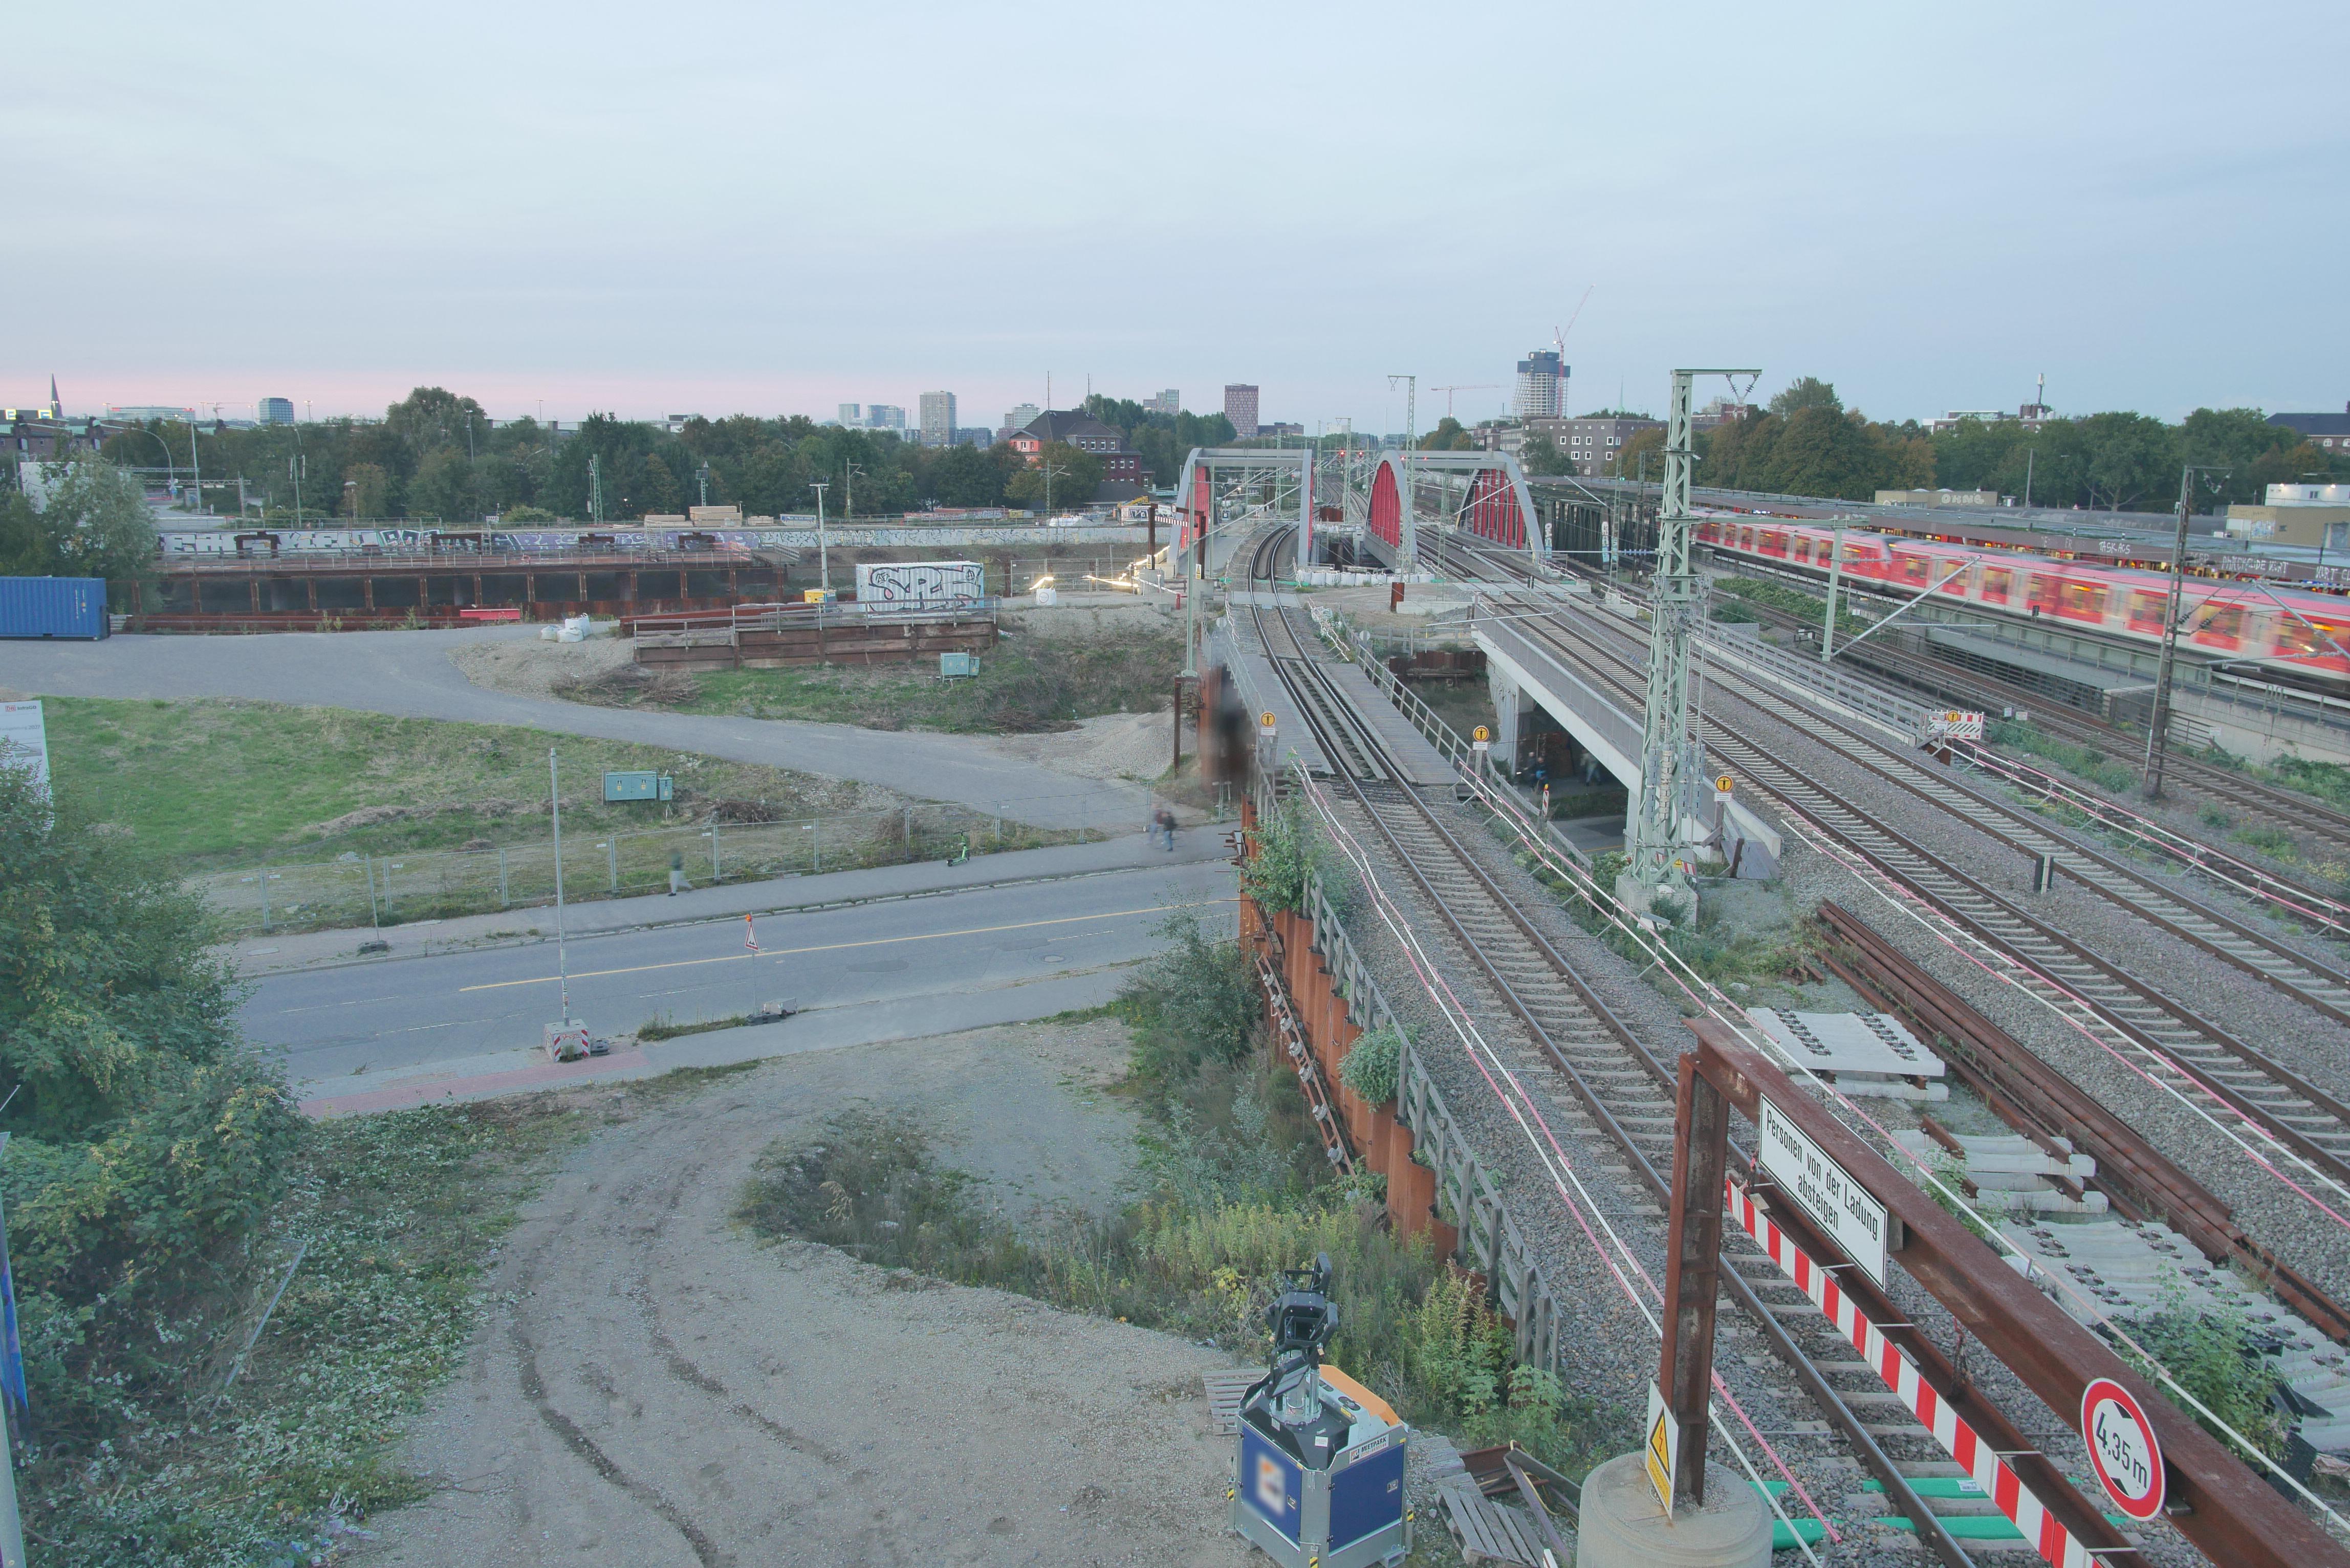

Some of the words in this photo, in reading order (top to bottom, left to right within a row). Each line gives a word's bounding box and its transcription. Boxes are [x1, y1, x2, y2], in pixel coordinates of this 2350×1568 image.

[1767, 1108, 1802, 1163] Personen
[1807, 1152, 1821, 1182] von
[1826, 1168, 1840, 1199] der
[1844, 1183, 1878, 1242] Ladung
[1798, 1173, 1838, 1231] absteigen
[1361, 1436, 1387, 1453] MIETPARK
